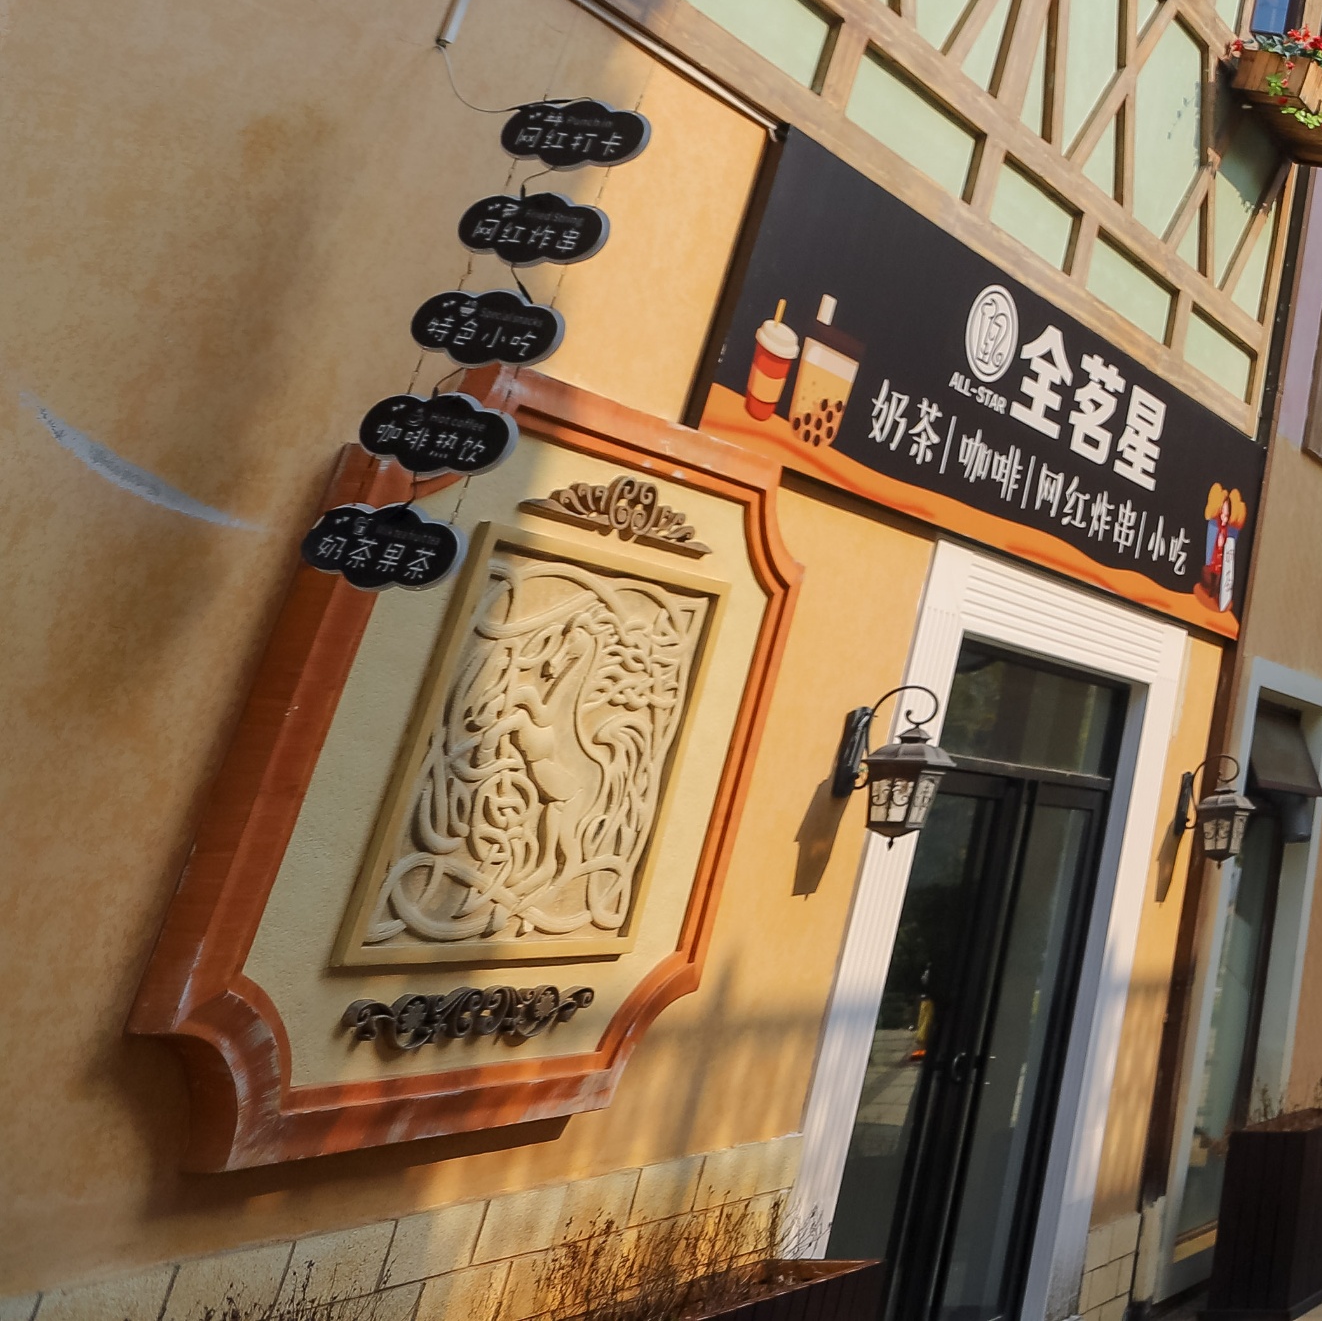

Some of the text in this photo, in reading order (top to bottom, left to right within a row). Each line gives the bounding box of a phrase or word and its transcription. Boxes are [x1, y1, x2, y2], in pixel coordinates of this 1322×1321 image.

[514, 126, 624, 157] 网红打卡
[471, 218, 581, 253] 网红炸串
[427, 315, 538, 357] 特色小吃
[948, 372, 1008, 415] ALL-STAR
[1009, 324, 1168, 492] 全茗星
[376, 420, 487, 463] 咖啡热饮
[317, 534, 437, 579] 奶茶果茶
